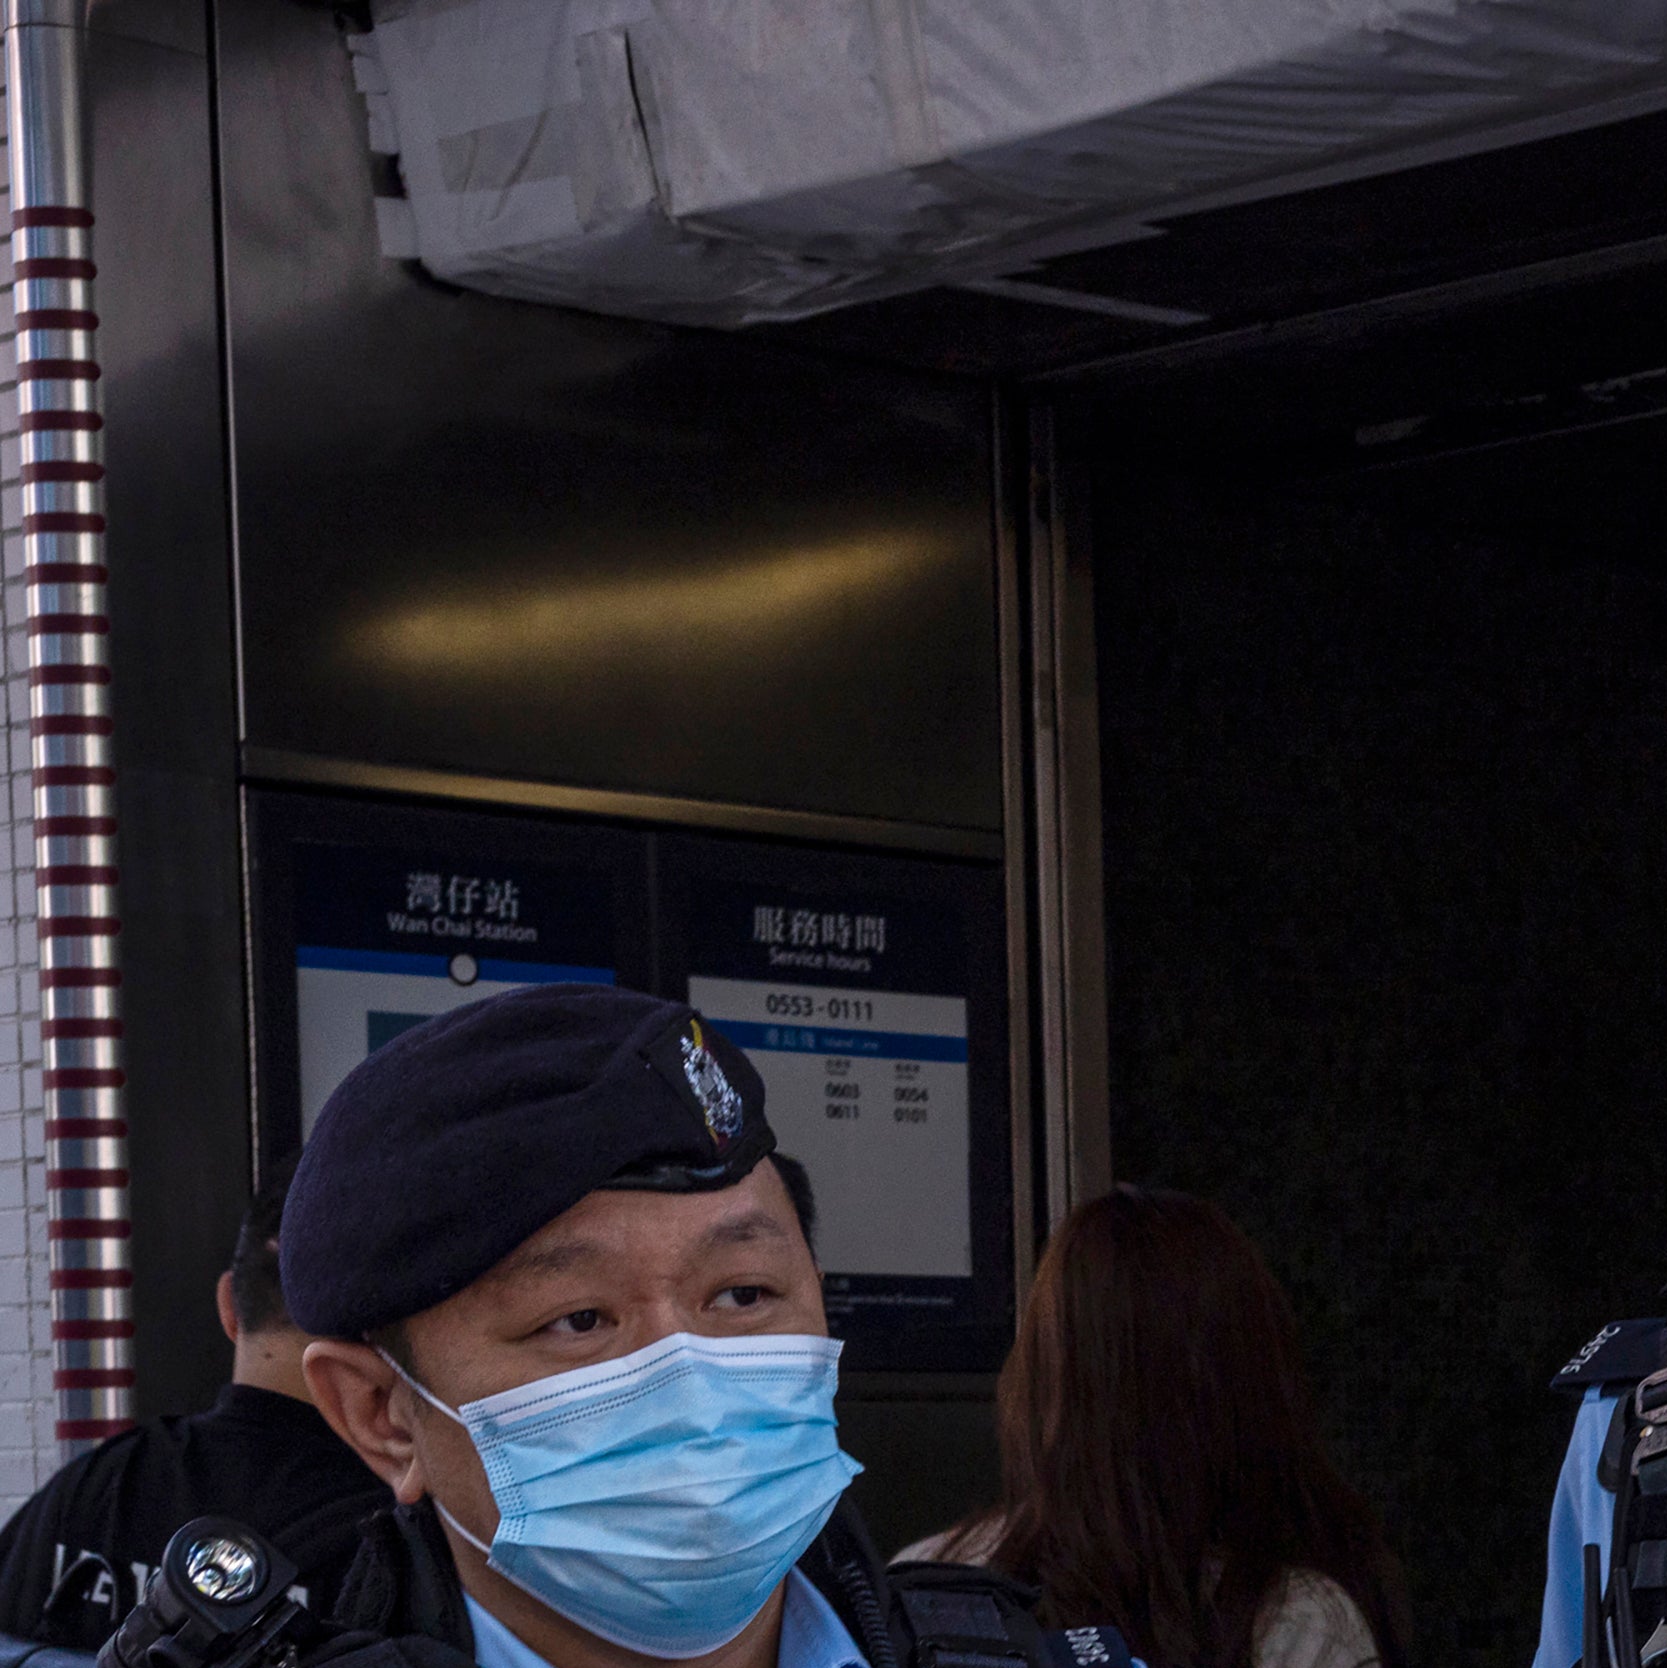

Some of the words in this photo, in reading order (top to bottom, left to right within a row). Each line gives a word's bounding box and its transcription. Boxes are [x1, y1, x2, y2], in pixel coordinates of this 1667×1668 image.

[387, 911, 428, 932] Wan
[431, 915, 472, 937] Chai
[474, 919, 538, 941] Station
